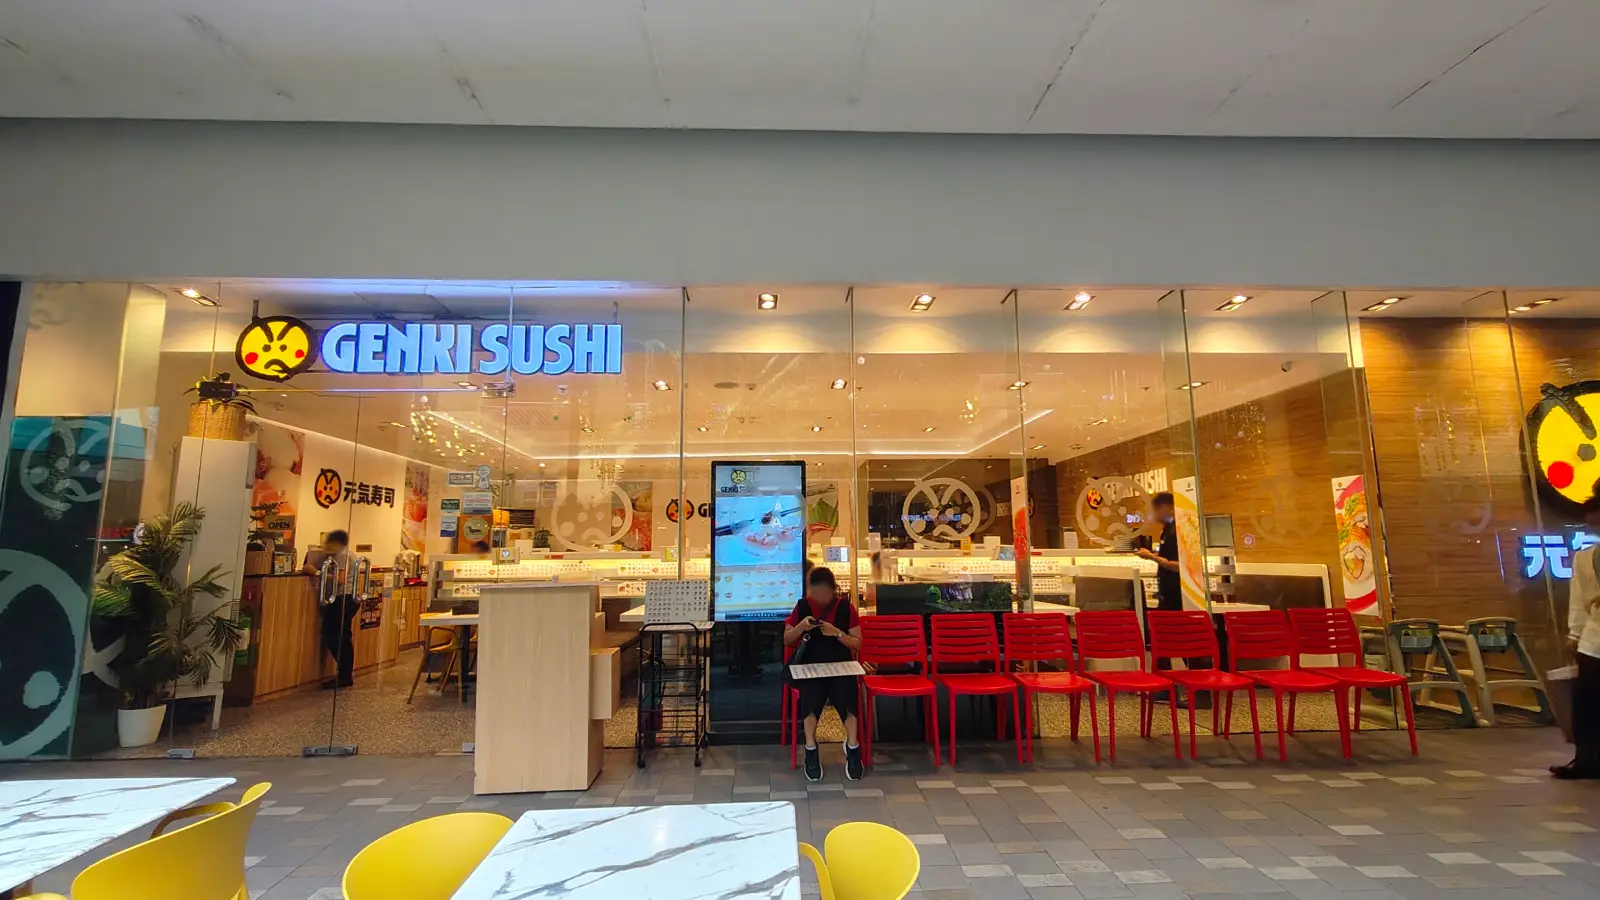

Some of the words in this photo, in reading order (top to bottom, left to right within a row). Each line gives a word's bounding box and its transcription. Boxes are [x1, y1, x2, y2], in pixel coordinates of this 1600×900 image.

[321, 322, 473, 374] GENKI
[480, 323, 623, 375] SUSHI
[343, 481, 395, 508] 元気寿司
[268, 521, 290, 529] OPEN
